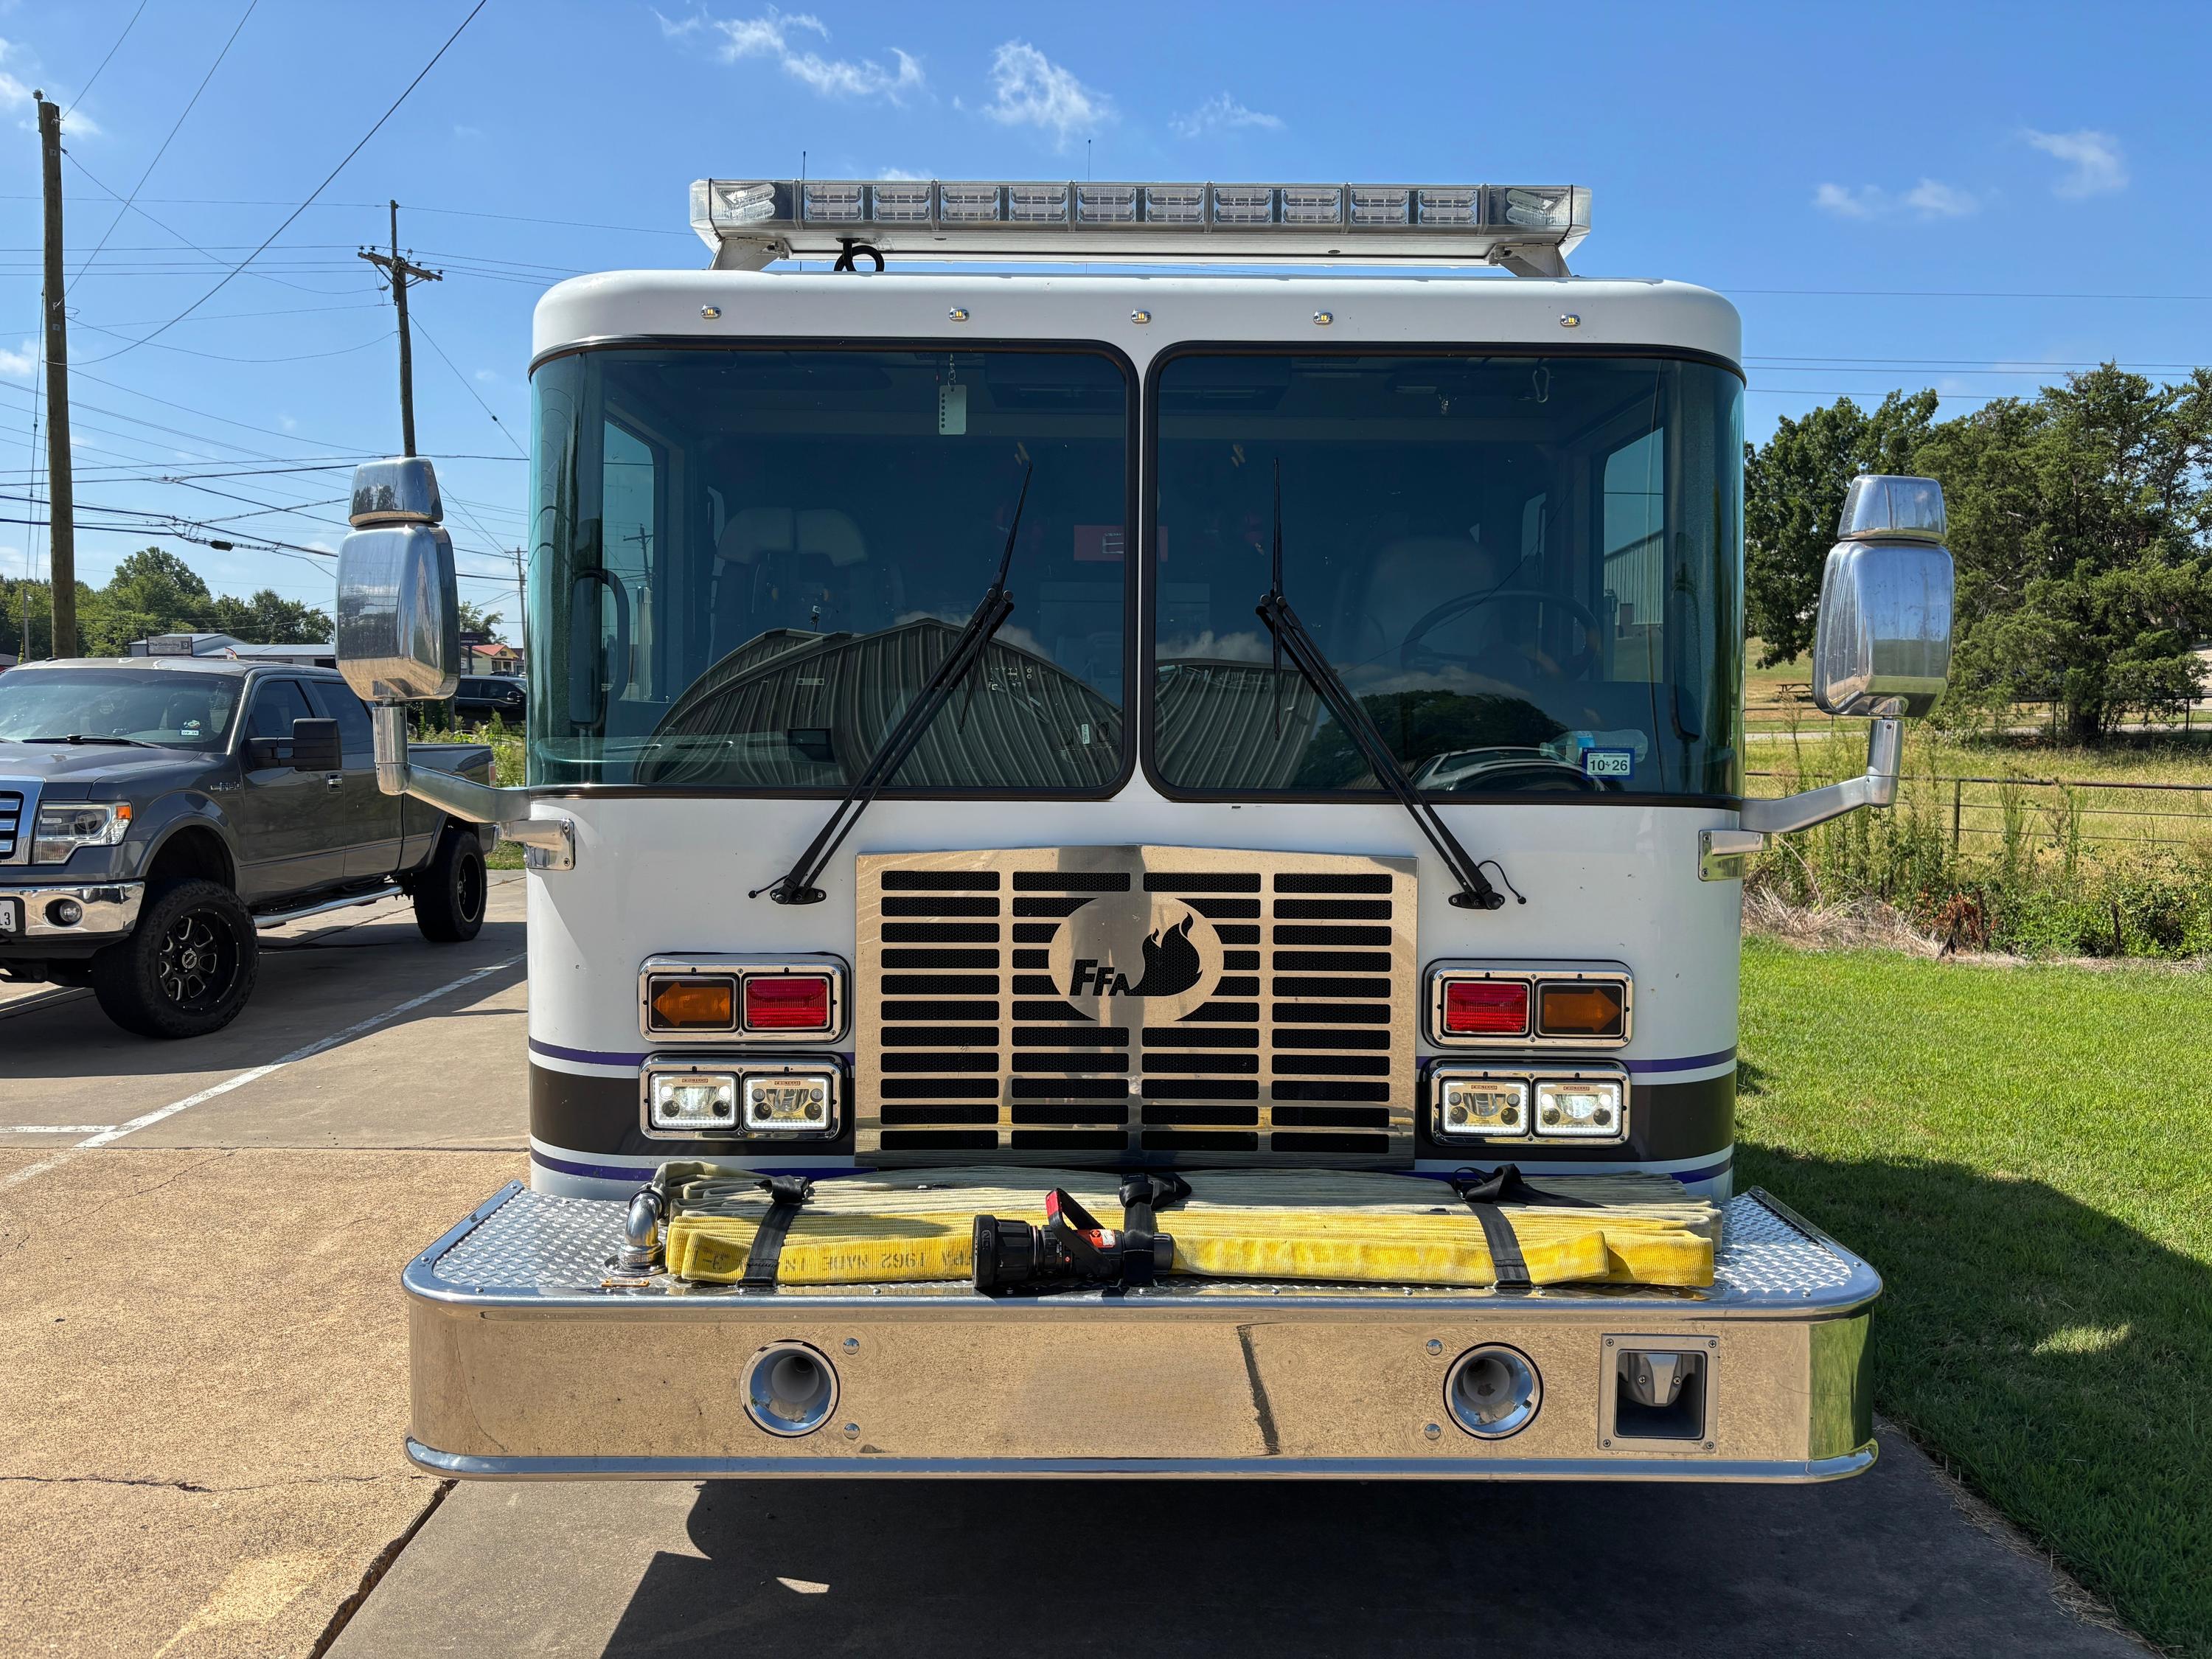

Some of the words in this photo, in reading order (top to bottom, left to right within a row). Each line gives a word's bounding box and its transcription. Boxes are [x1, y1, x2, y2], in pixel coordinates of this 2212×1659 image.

[1069, 959, 1132, 997] FFA
[784, 1257, 806, 1273] IN
[822, 1254, 869, 1271] MADE
[881, 1251, 925, 1269] 1962
